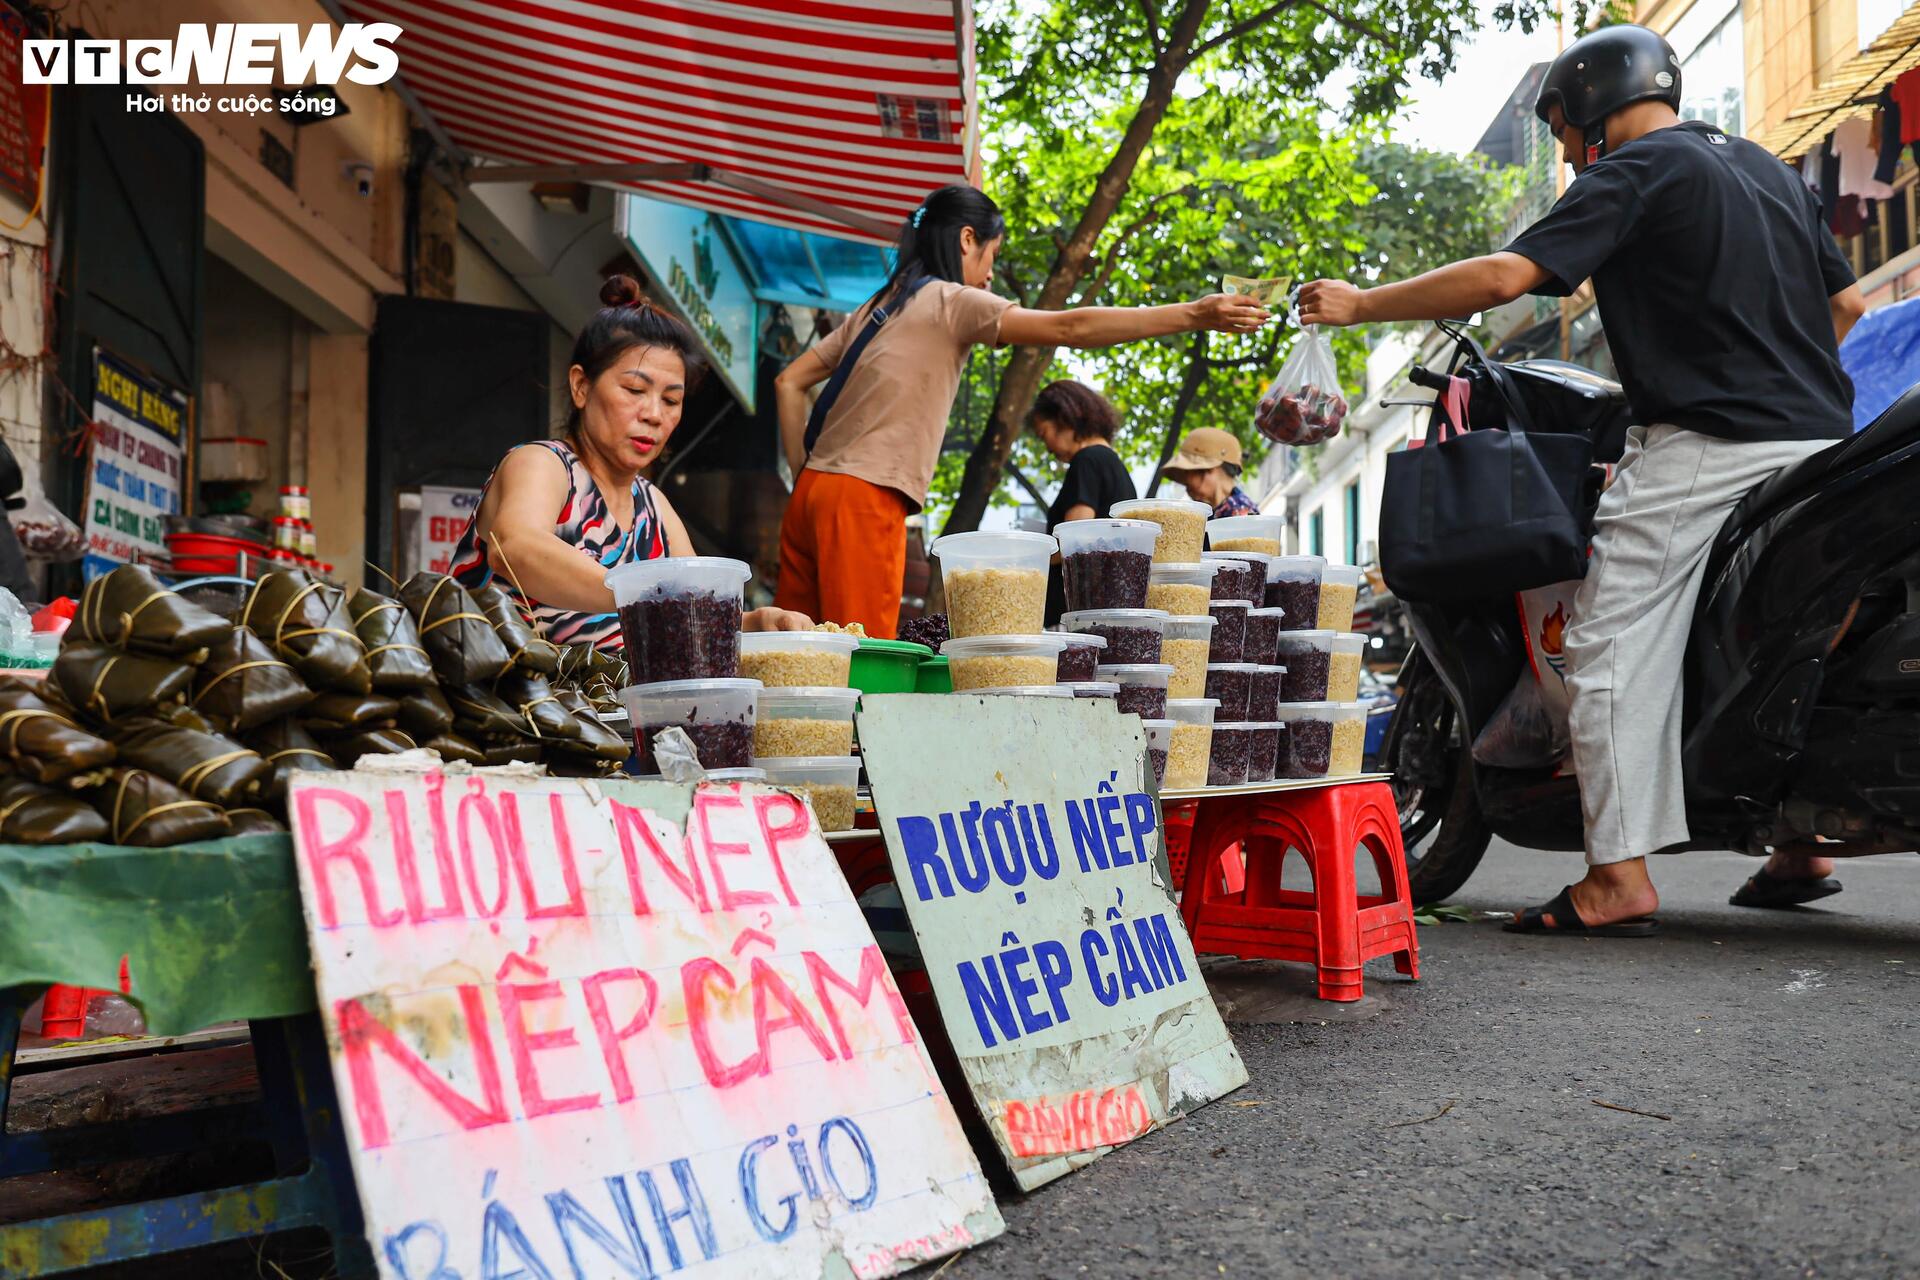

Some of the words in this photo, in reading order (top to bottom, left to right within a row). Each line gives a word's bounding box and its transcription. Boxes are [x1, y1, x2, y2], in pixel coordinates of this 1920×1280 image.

[896, 800, 1060, 904] RƯỢU
[1064, 770, 1156, 873] NẾP
[1080, 886, 1188, 1008] CẨM
[333, 934, 660, 1151] NẾP
[679, 911, 917, 1089] CẨM
[383, 1157, 719, 1280] BÁNH
